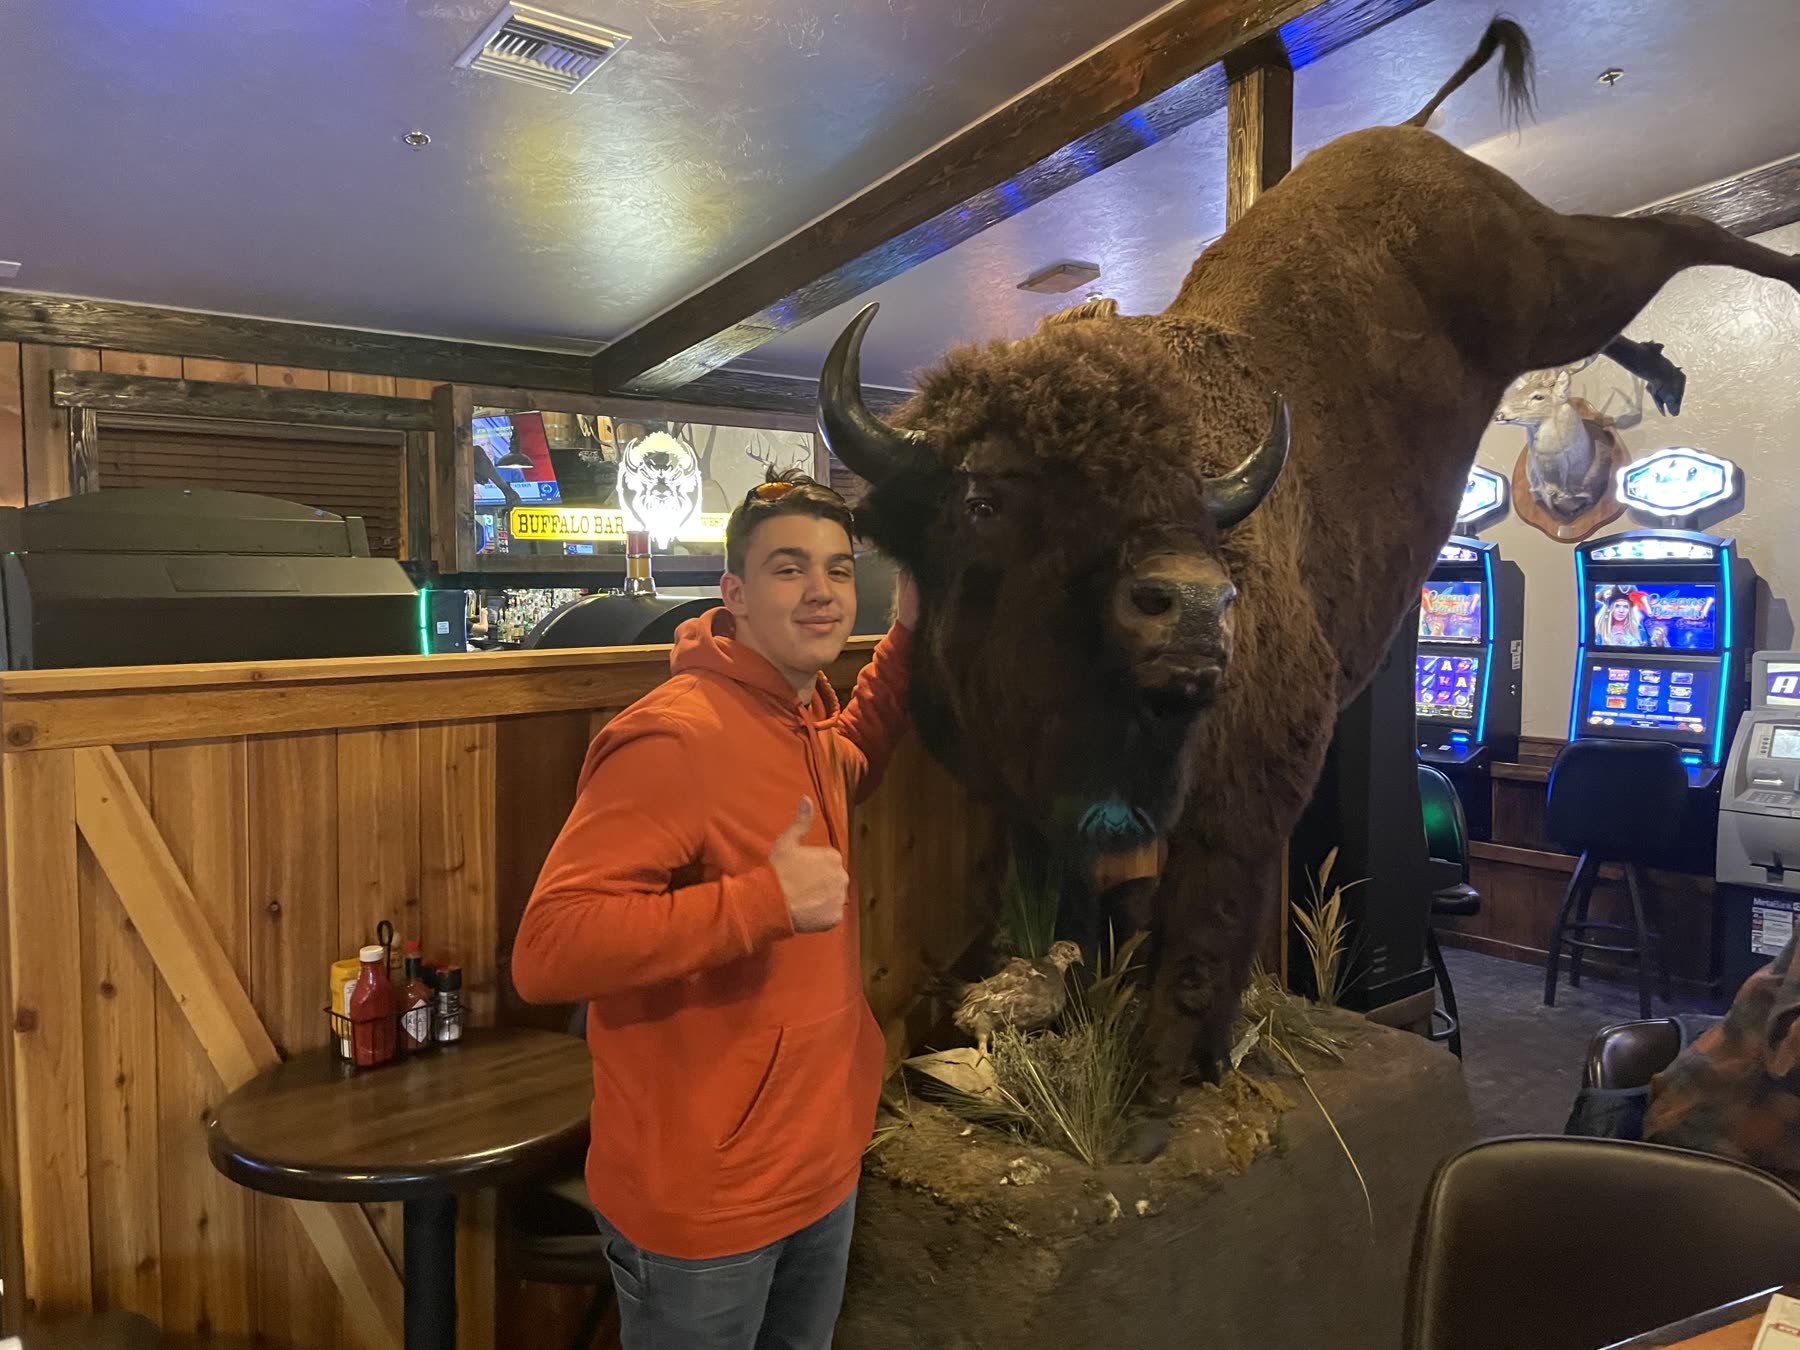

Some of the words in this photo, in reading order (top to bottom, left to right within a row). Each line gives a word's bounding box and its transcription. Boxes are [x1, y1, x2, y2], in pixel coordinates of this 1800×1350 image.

[518, 513, 590, 534] BUFFALO
[594, 516, 625, 534] BAR
[1647, 593, 1706, 606] Oceans
[1650, 605, 1703, 619] Beauty
[1770, 675, 1799, 694] A
